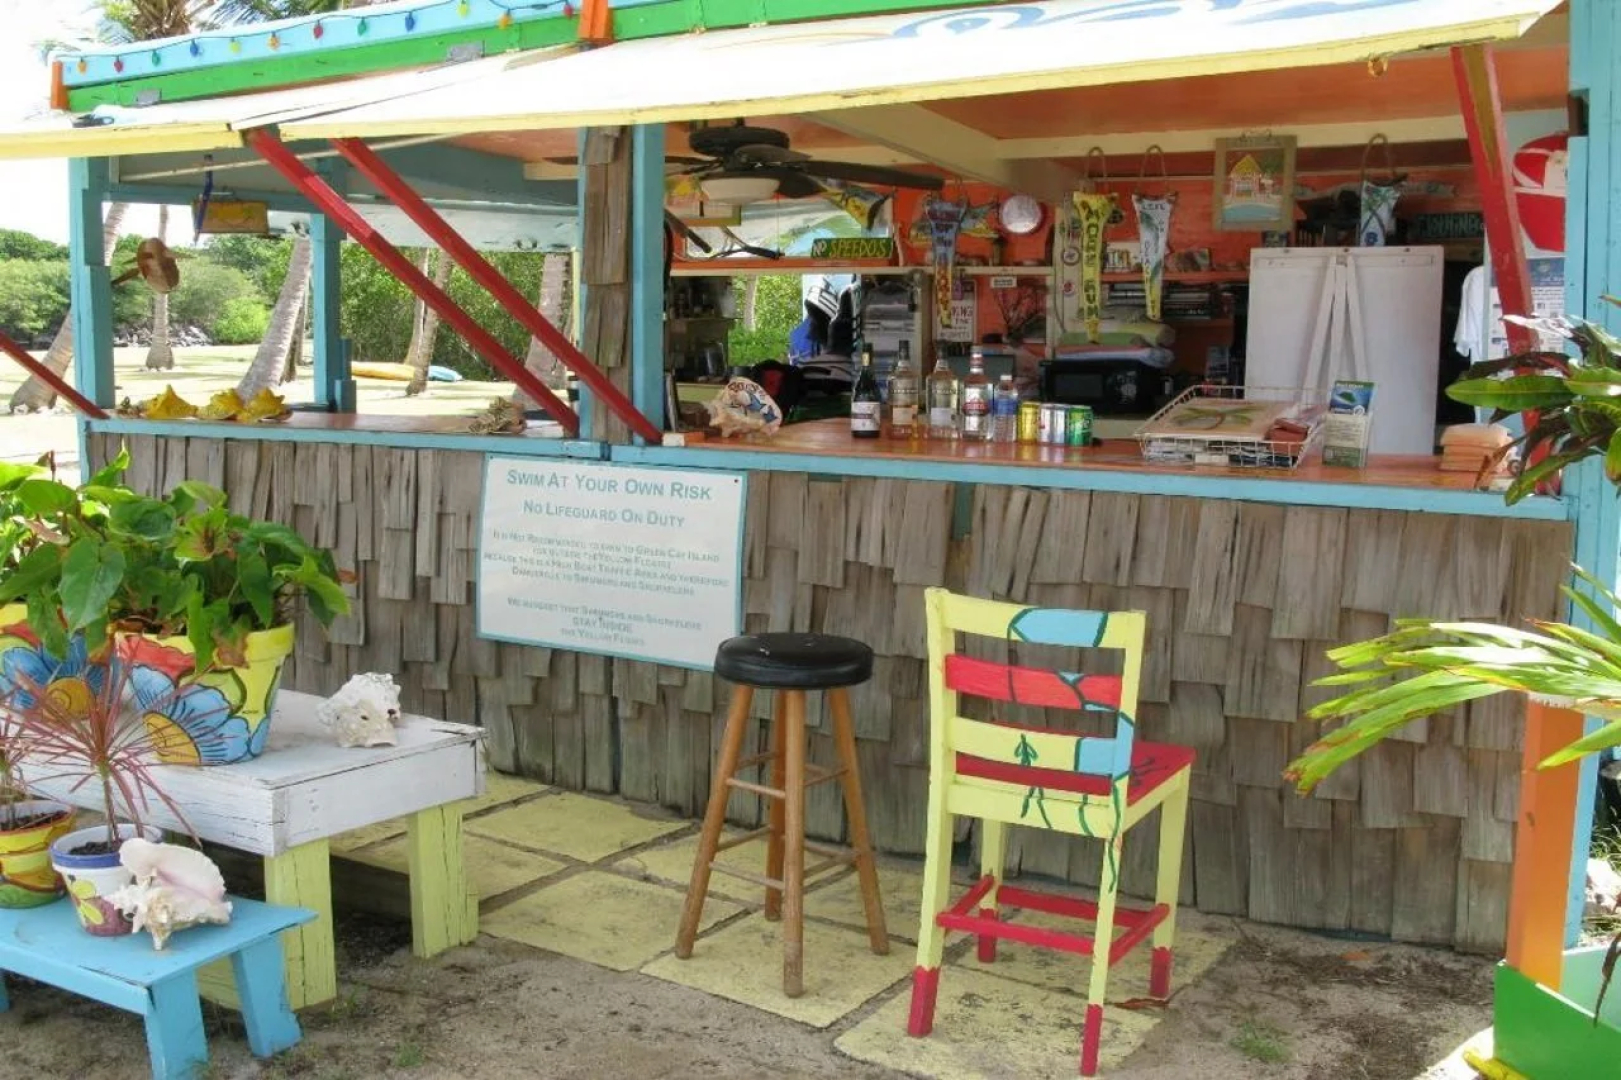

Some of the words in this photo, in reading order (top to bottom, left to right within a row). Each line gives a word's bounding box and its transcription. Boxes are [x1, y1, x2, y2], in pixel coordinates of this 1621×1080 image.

[507, 469, 544, 487] SWIM
[547, 471, 567, 488] AT
[575, 473, 618, 493] YOUR
[625, 478, 664, 496] OWN
[670, 481, 711, 500] RISK
[523, 499, 543, 514] NO
[546, 502, 618, 522] LIFEGUARD
[621, 508, 642, 524] ON
[647, 510, 685, 528] DUTY
[688, 550, 719, 563] ISLAND
